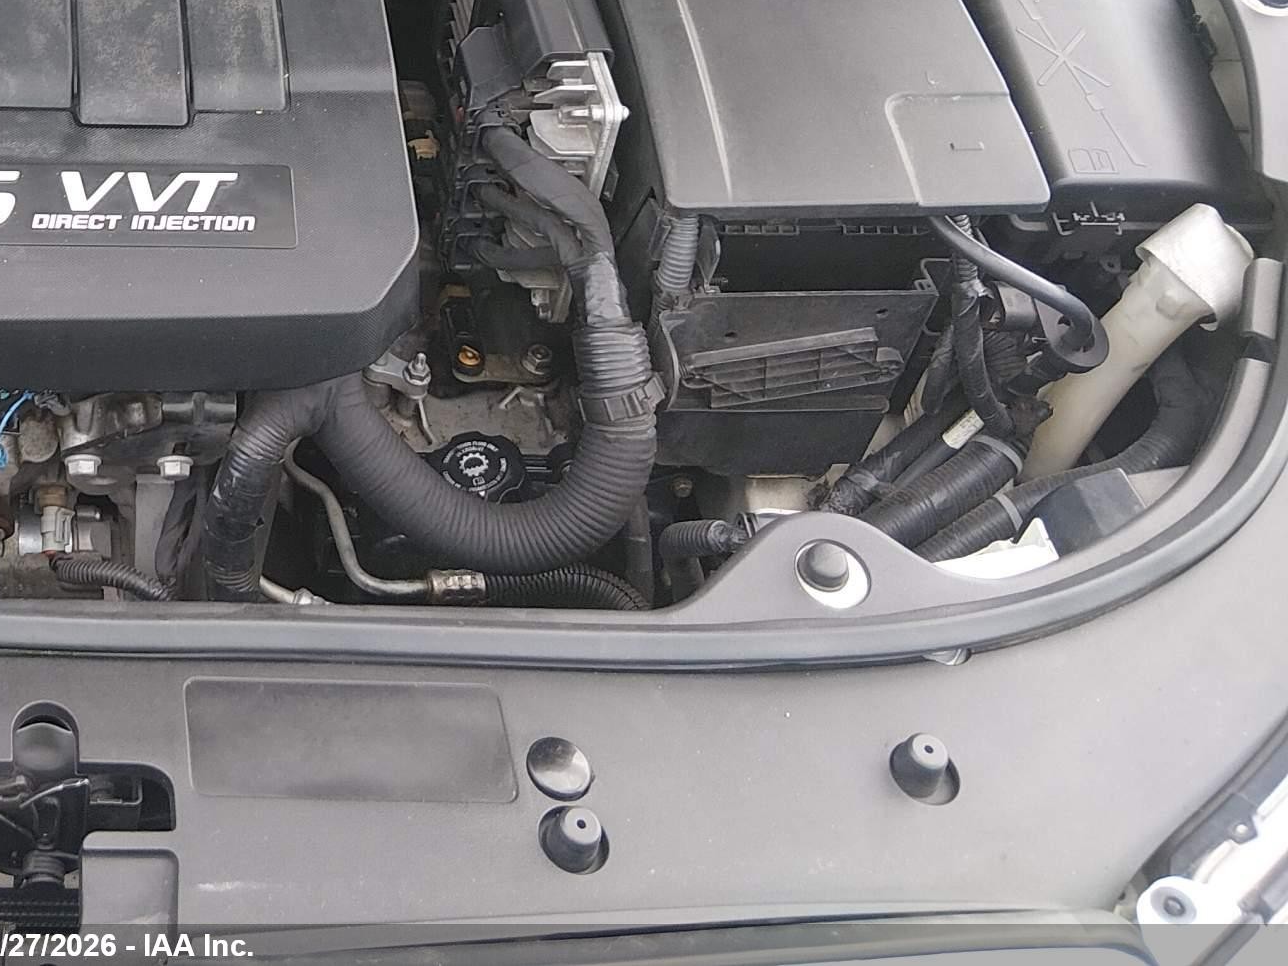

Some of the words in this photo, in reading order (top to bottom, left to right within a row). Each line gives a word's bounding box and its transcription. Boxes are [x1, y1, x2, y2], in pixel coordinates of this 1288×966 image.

[62, 172, 237, 211] VVT
[31, 213, 122, 231] DIRECT
[131, 214, 256, 231] INJECTION
